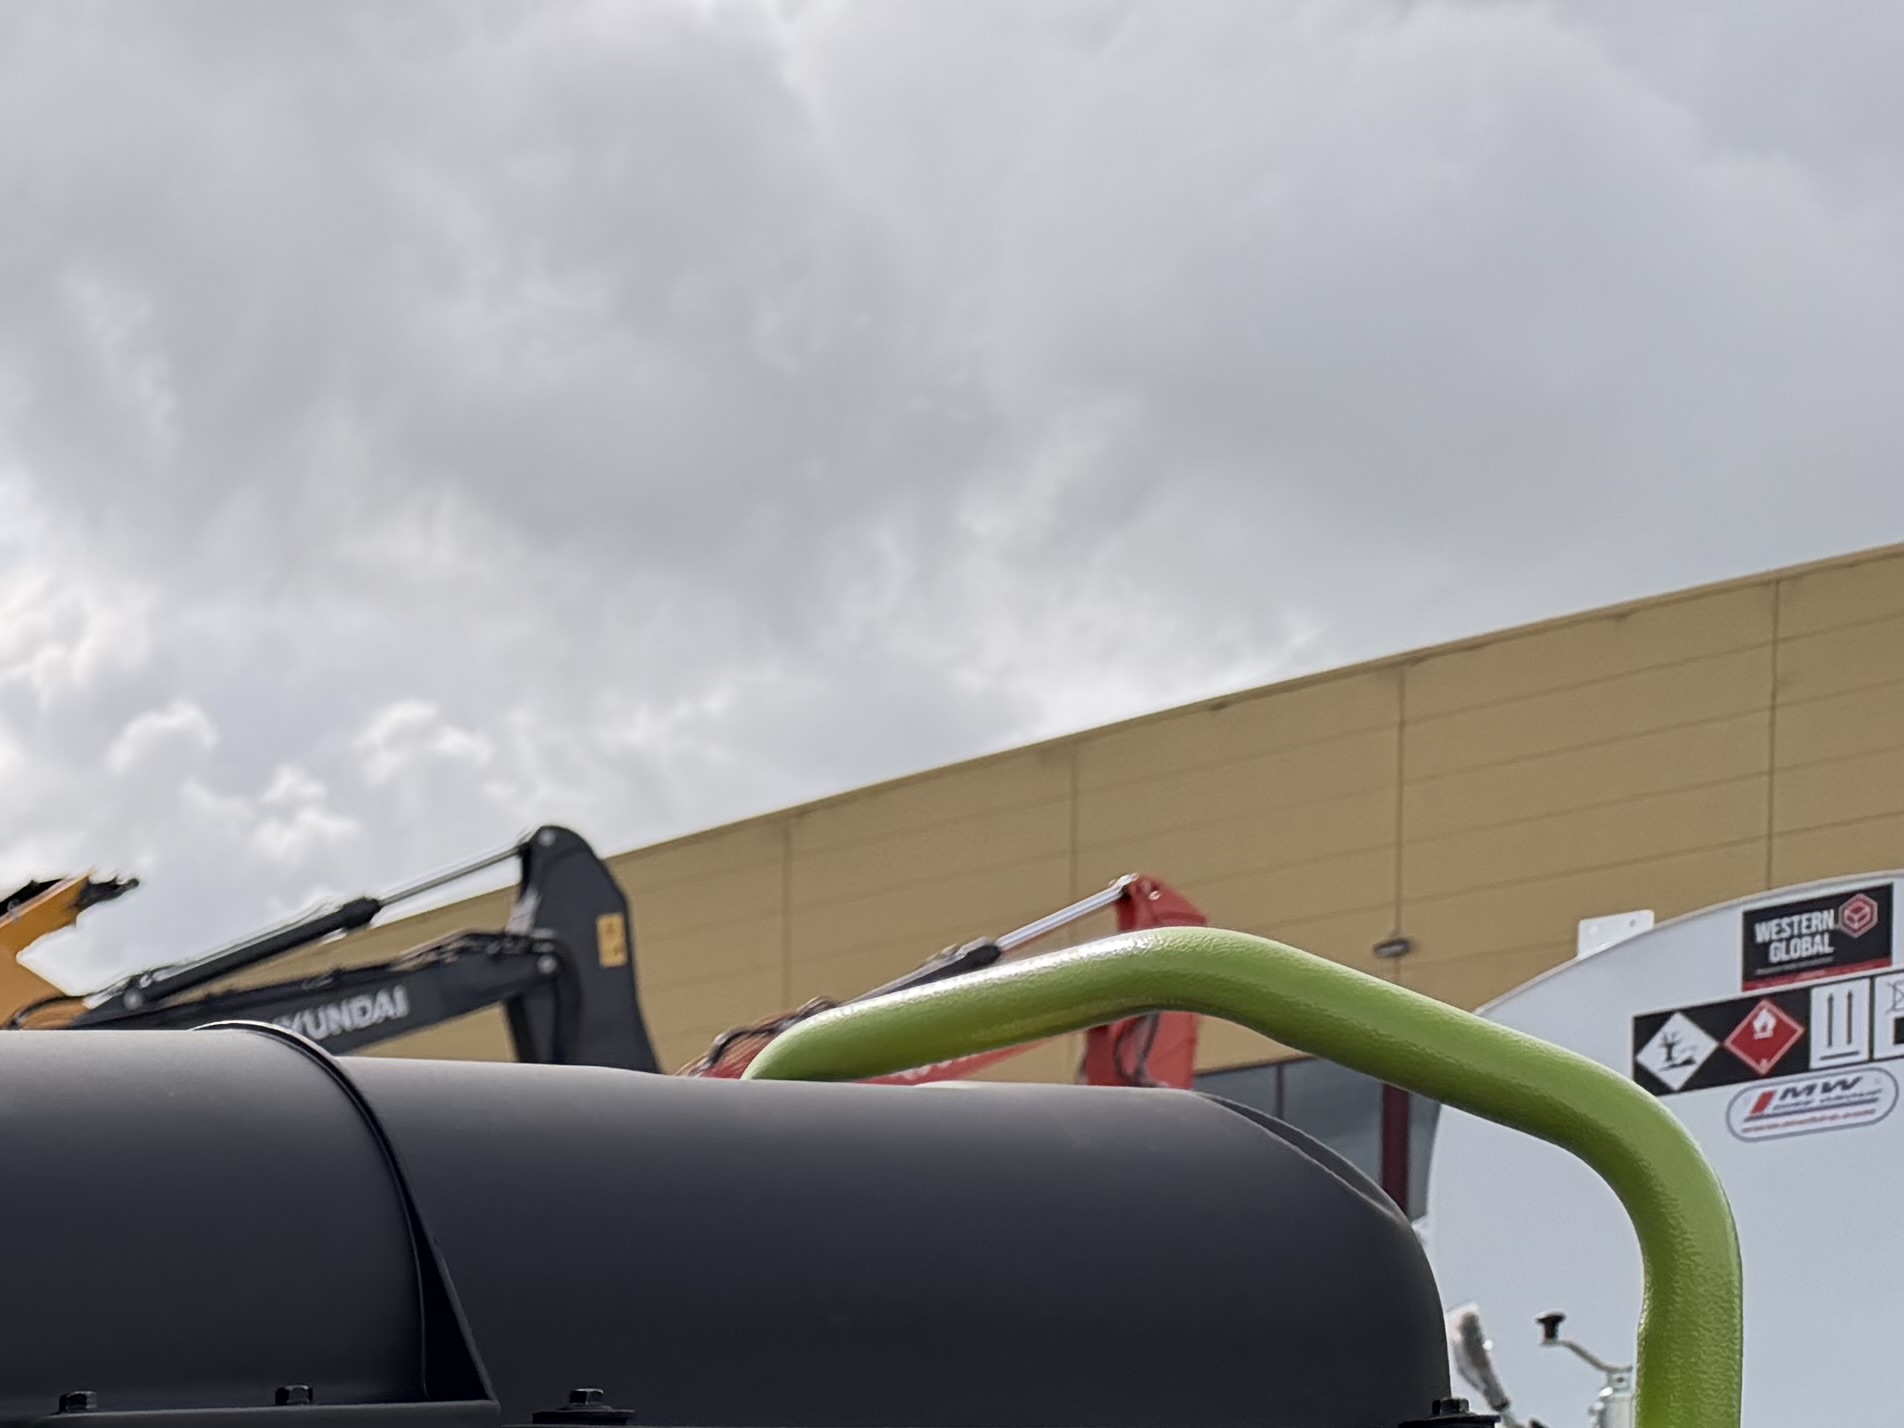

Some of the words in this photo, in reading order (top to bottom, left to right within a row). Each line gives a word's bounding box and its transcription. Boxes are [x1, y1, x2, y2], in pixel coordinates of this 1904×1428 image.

[1754, 909, 1835, 943] WESTERN
[1769, 933, 1835, 964] GLOBAL
[273, 985, 409, 1040] YUNDAI
